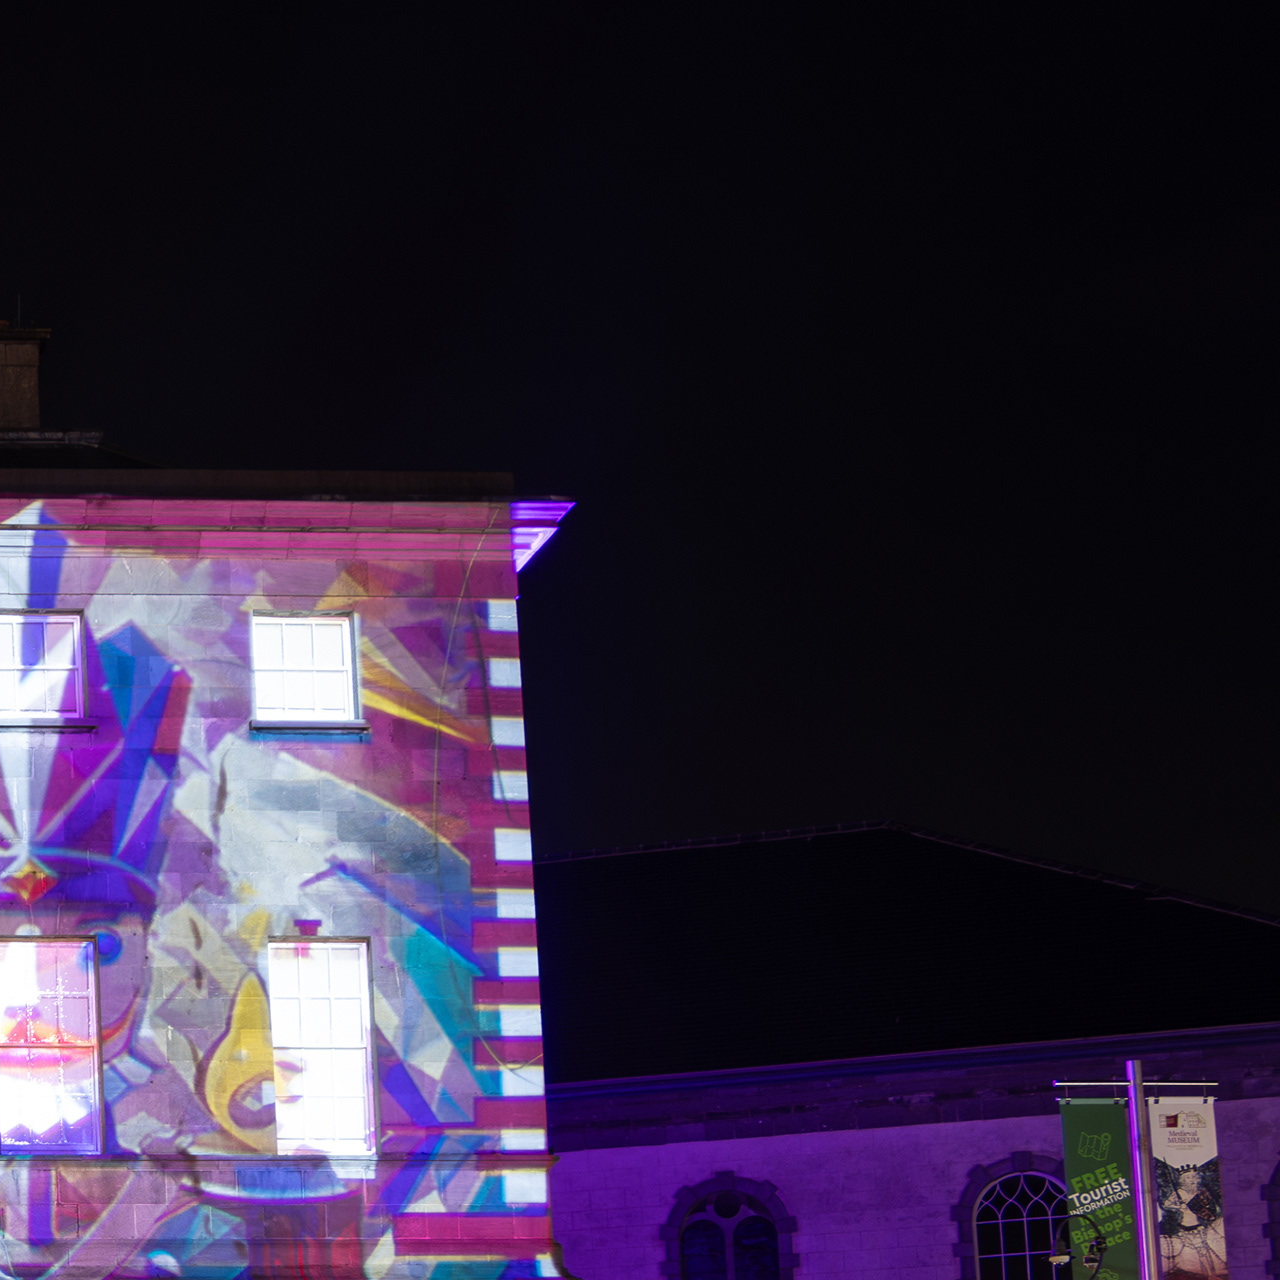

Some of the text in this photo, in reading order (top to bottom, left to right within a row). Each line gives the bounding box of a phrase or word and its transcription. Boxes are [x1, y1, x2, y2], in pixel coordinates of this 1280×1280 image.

[1071, 1162, 1122, 1193] FREE
[1068, 1177, 1129, 1207] Tourist
[1069, 1189, 1131, 1215] INFORMATION
[1096, 1203, 1122, 1219] the
[1081, 1231, 1132, 1256] Pace
